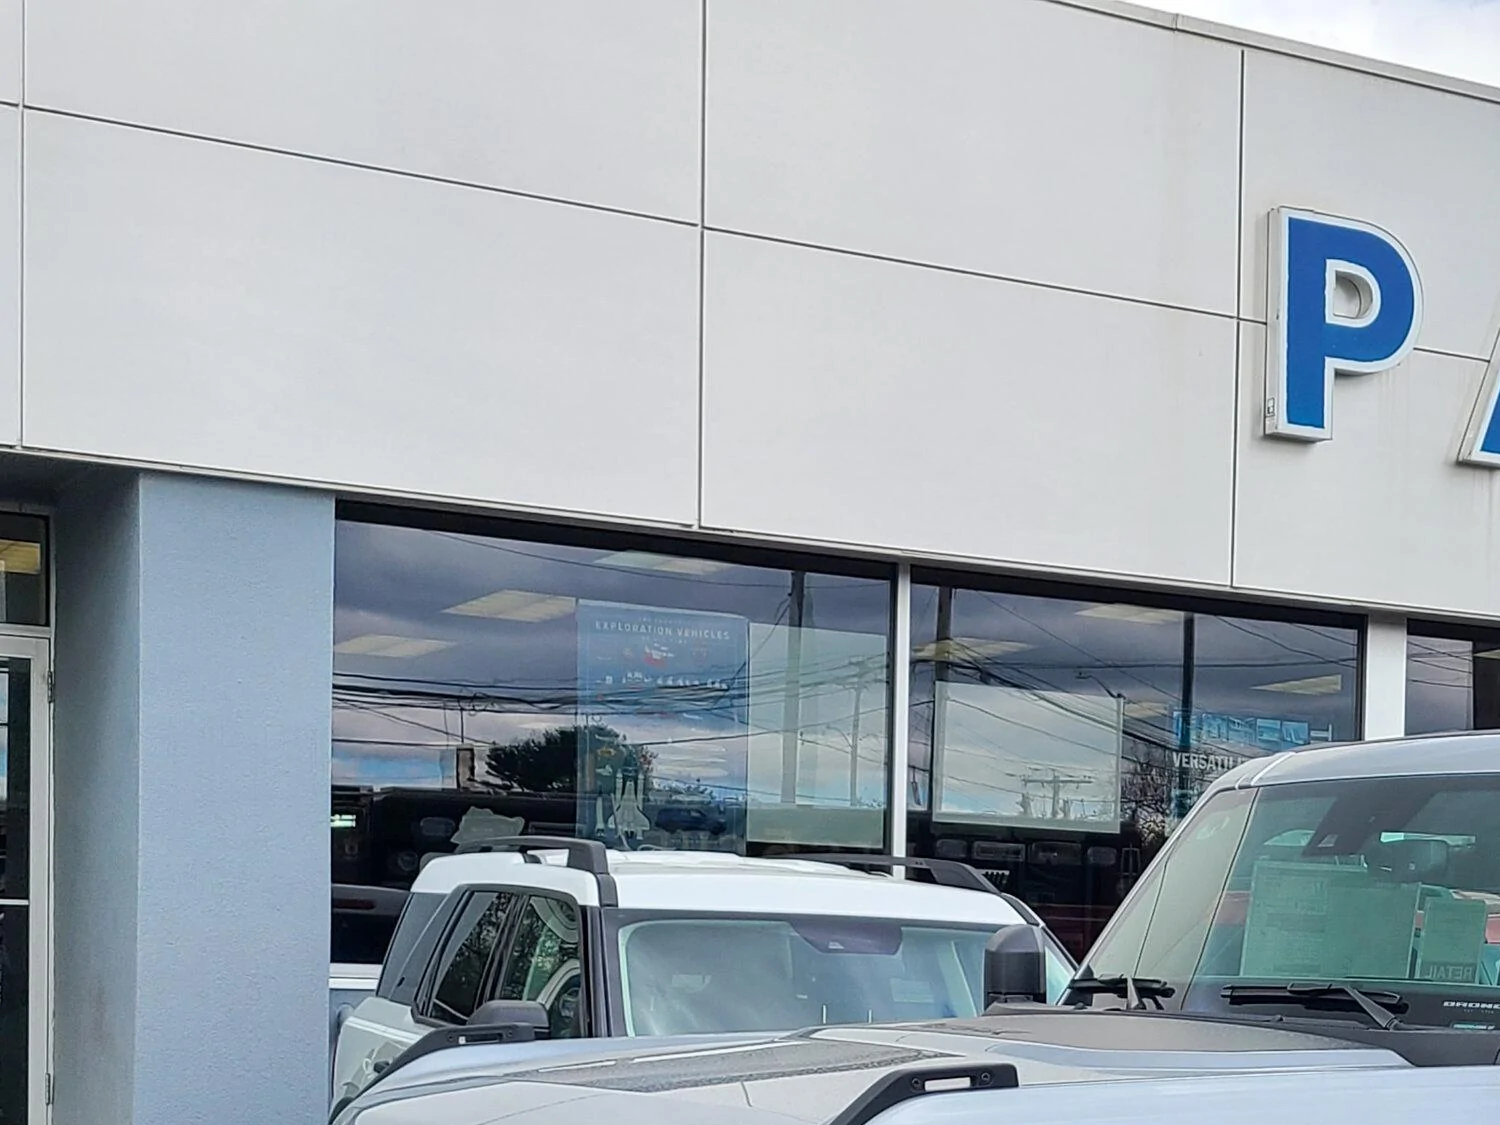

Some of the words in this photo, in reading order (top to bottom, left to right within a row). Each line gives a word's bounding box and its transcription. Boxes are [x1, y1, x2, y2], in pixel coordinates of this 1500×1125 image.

[596, 621, 673, 636] EXPLORATION
[677, 627, 731, 640] VEHICLES
[1172, 751, 1250, 770] VERSATIL
